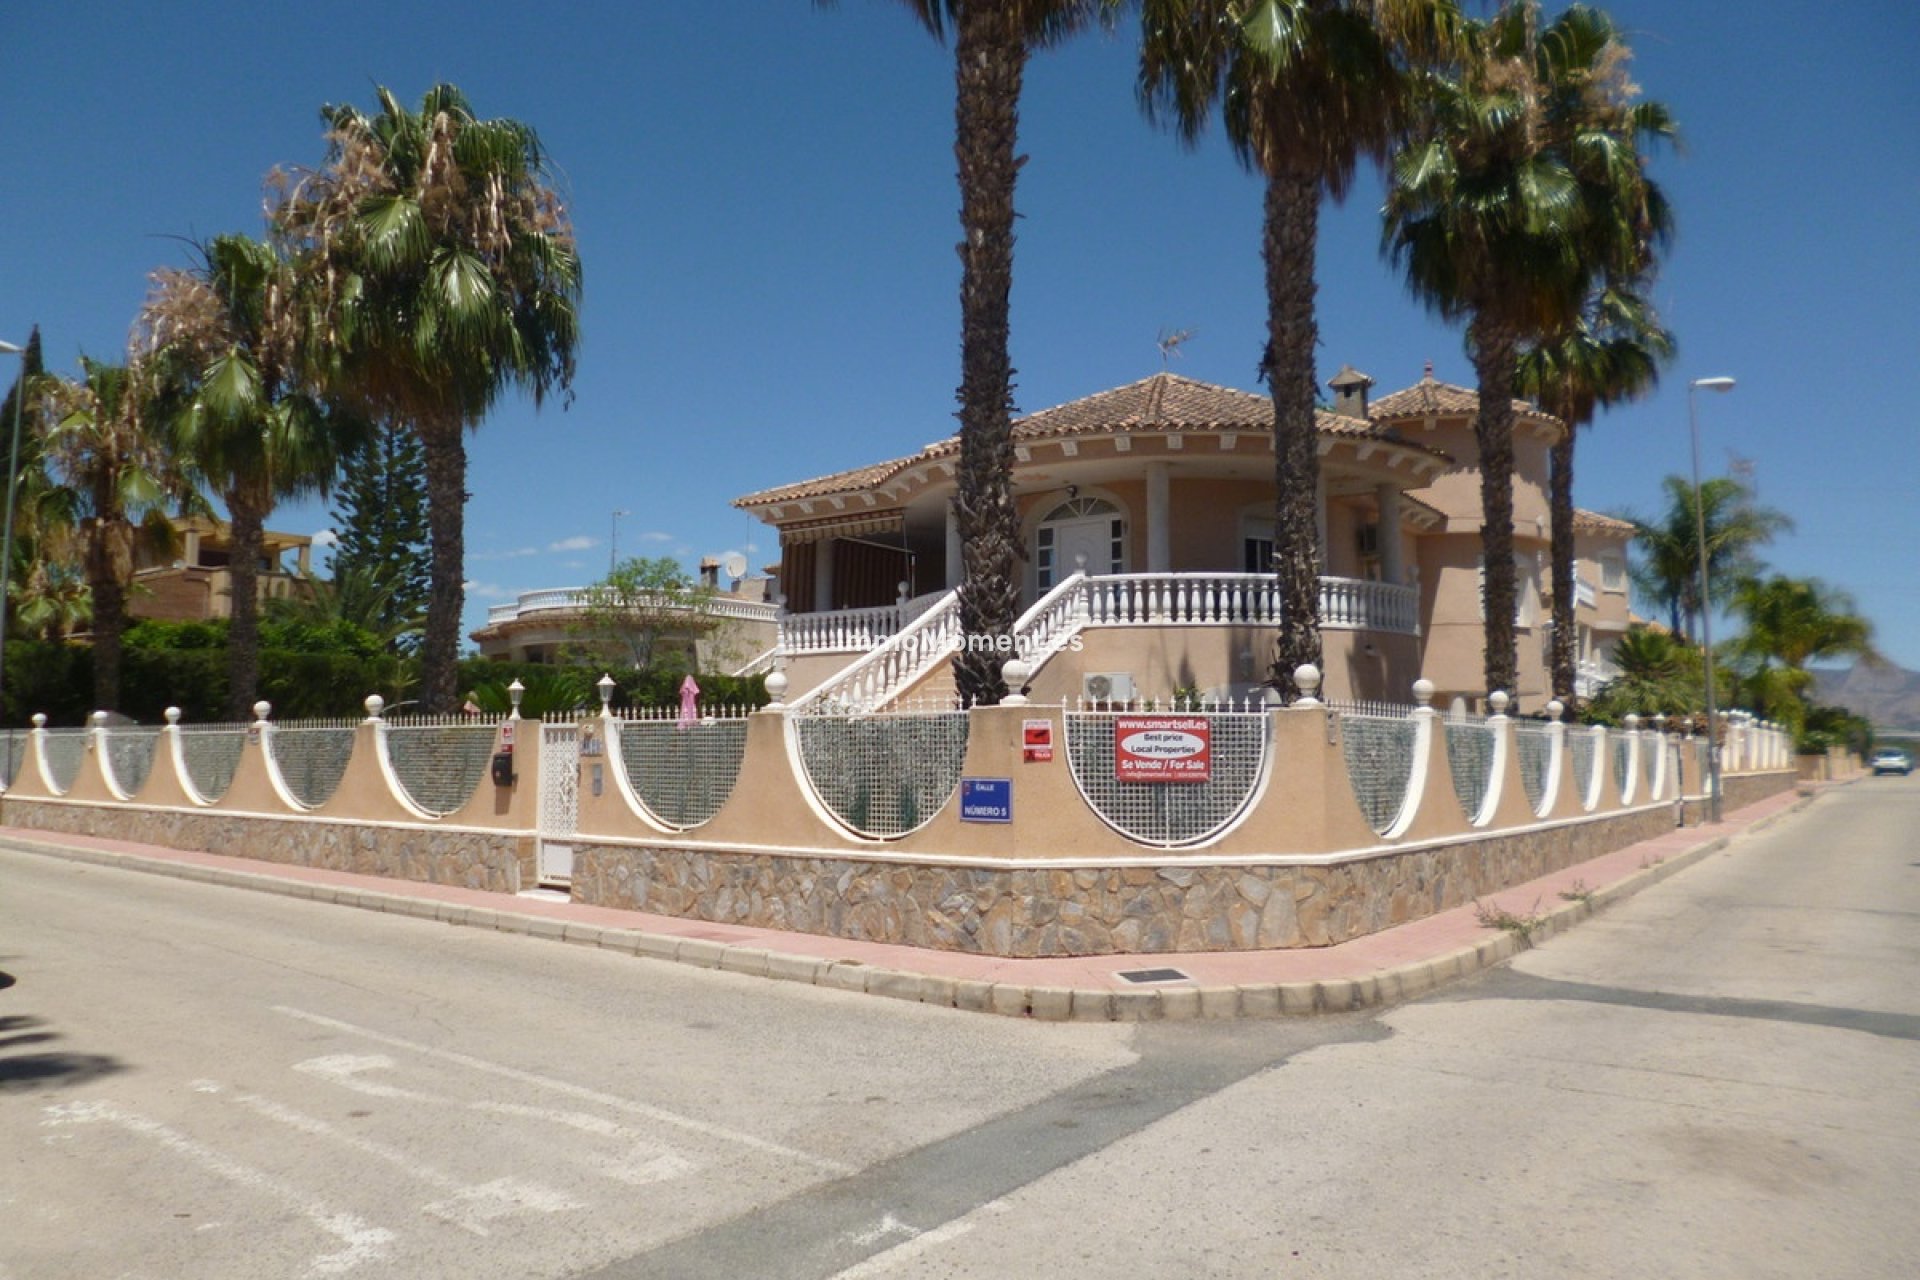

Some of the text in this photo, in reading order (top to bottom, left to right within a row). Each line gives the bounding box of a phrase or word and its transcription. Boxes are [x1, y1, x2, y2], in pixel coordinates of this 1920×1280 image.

[1119, 719, 1207, 730] www.smartsell.es
[1163, 734, 1183, 743] price
[1132, 745, 1195, 754] Local Properties
[1122, 760, 1133, 769] Se
[1135, 760, 1161, 769] Vende
[1169, 760, 1185, 769] For
[1186, 760, 1204, 769] Sale
